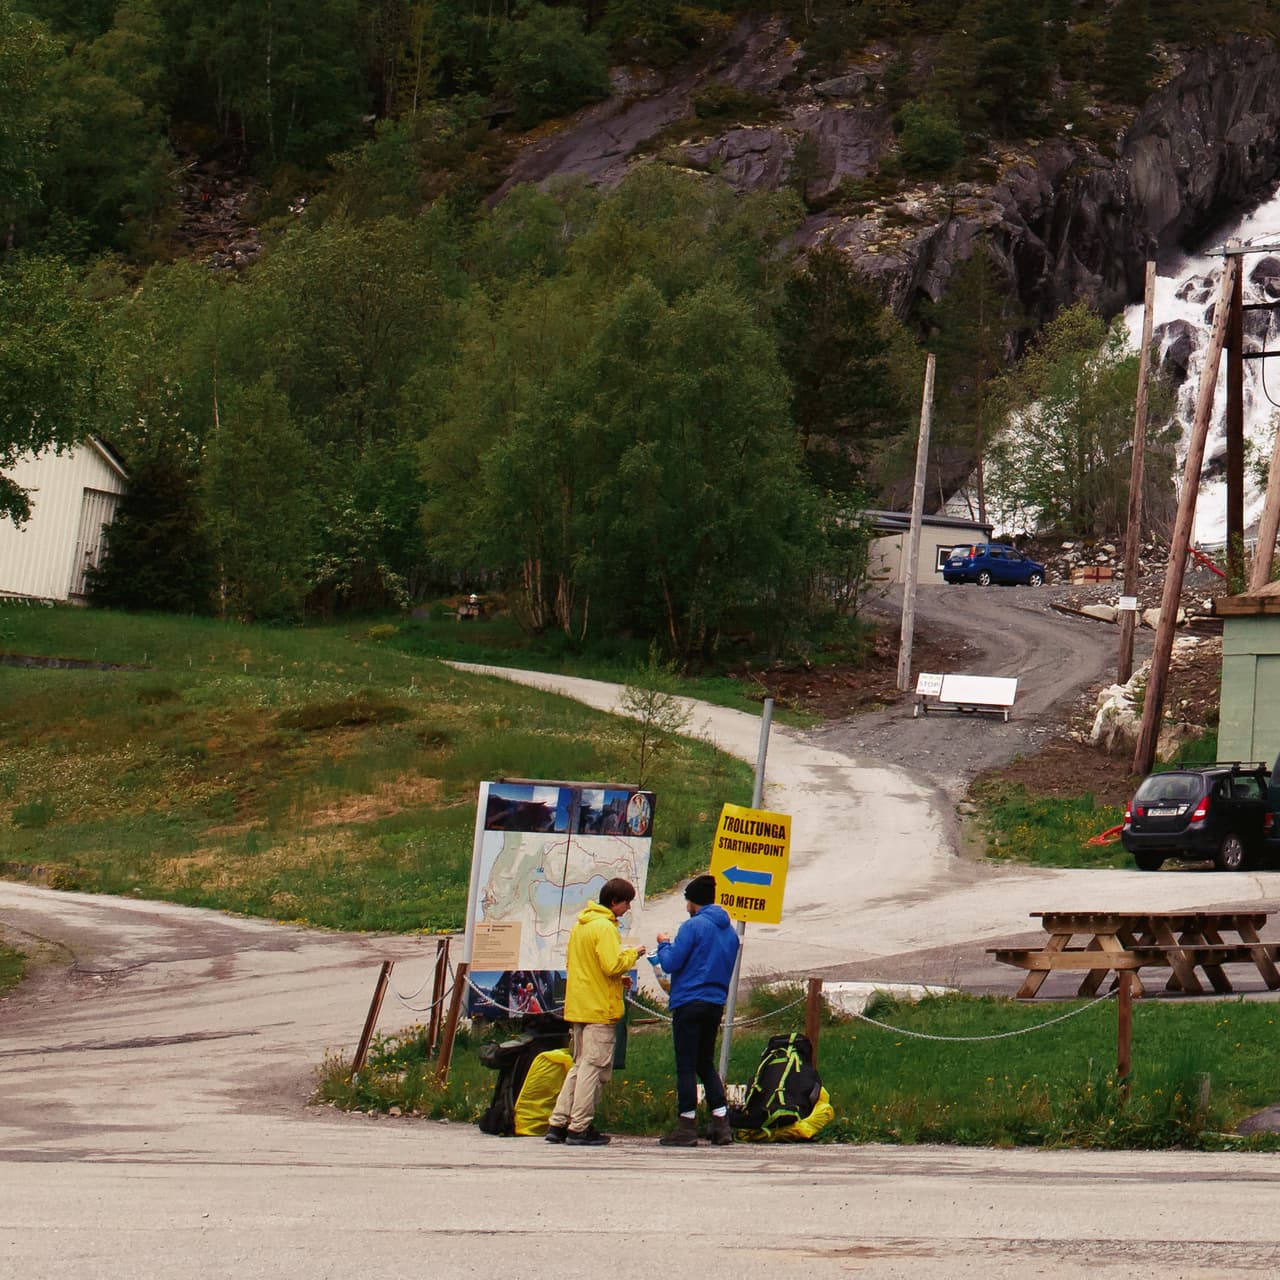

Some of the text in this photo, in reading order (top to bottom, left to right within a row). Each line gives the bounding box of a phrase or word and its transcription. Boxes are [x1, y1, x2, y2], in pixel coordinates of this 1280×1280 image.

[723, 815, 786, 840] TROLLTUNGA
[718, 836, 785, 857] STARTINGPOINT
[720, 893, 766, 911] 130 METER
